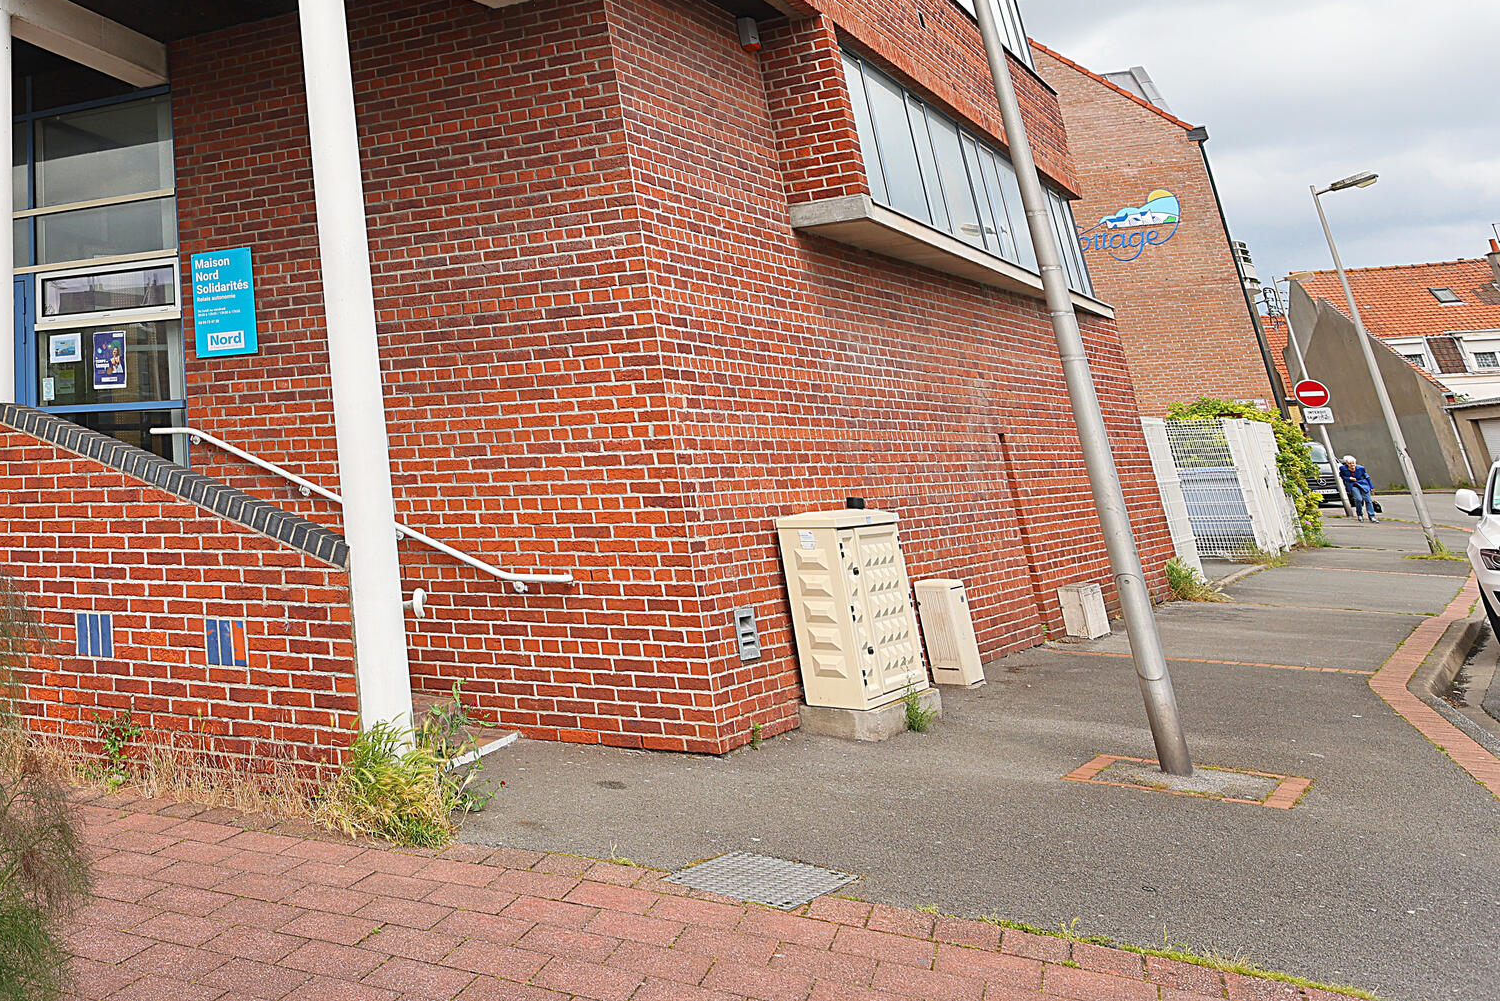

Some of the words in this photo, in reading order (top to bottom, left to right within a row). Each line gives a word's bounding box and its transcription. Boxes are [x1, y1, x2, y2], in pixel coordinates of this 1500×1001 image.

[1077, 230, 1161, 261] ottage
[194, 257, 230, 270] Maison
[195, 269, 219, 282] Nord
[196, 279, 249, 295] Solidarités
[210, 331, 242, 346] Nord
